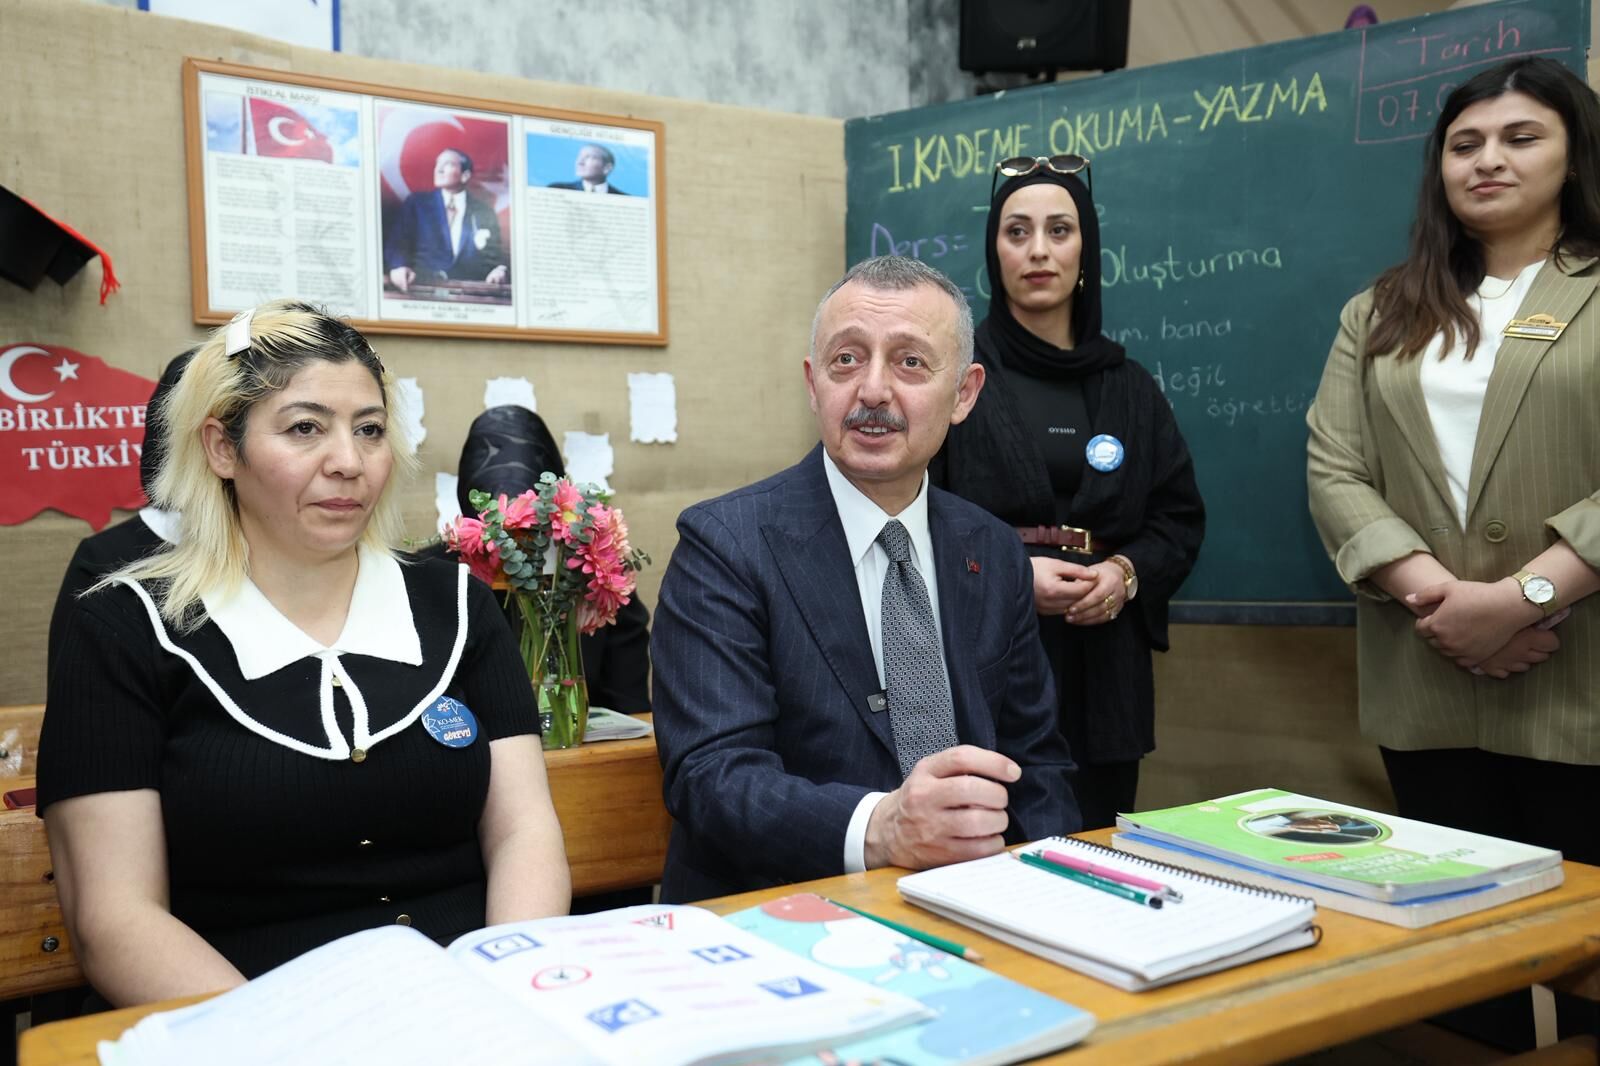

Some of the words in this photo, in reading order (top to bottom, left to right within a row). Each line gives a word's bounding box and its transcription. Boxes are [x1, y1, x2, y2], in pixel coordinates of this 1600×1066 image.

[1397, 20, 1521, 65] Tarih
[1161, 316, 1232, 340] bana
[0, 402, 147, 431] BİRLİKTE
